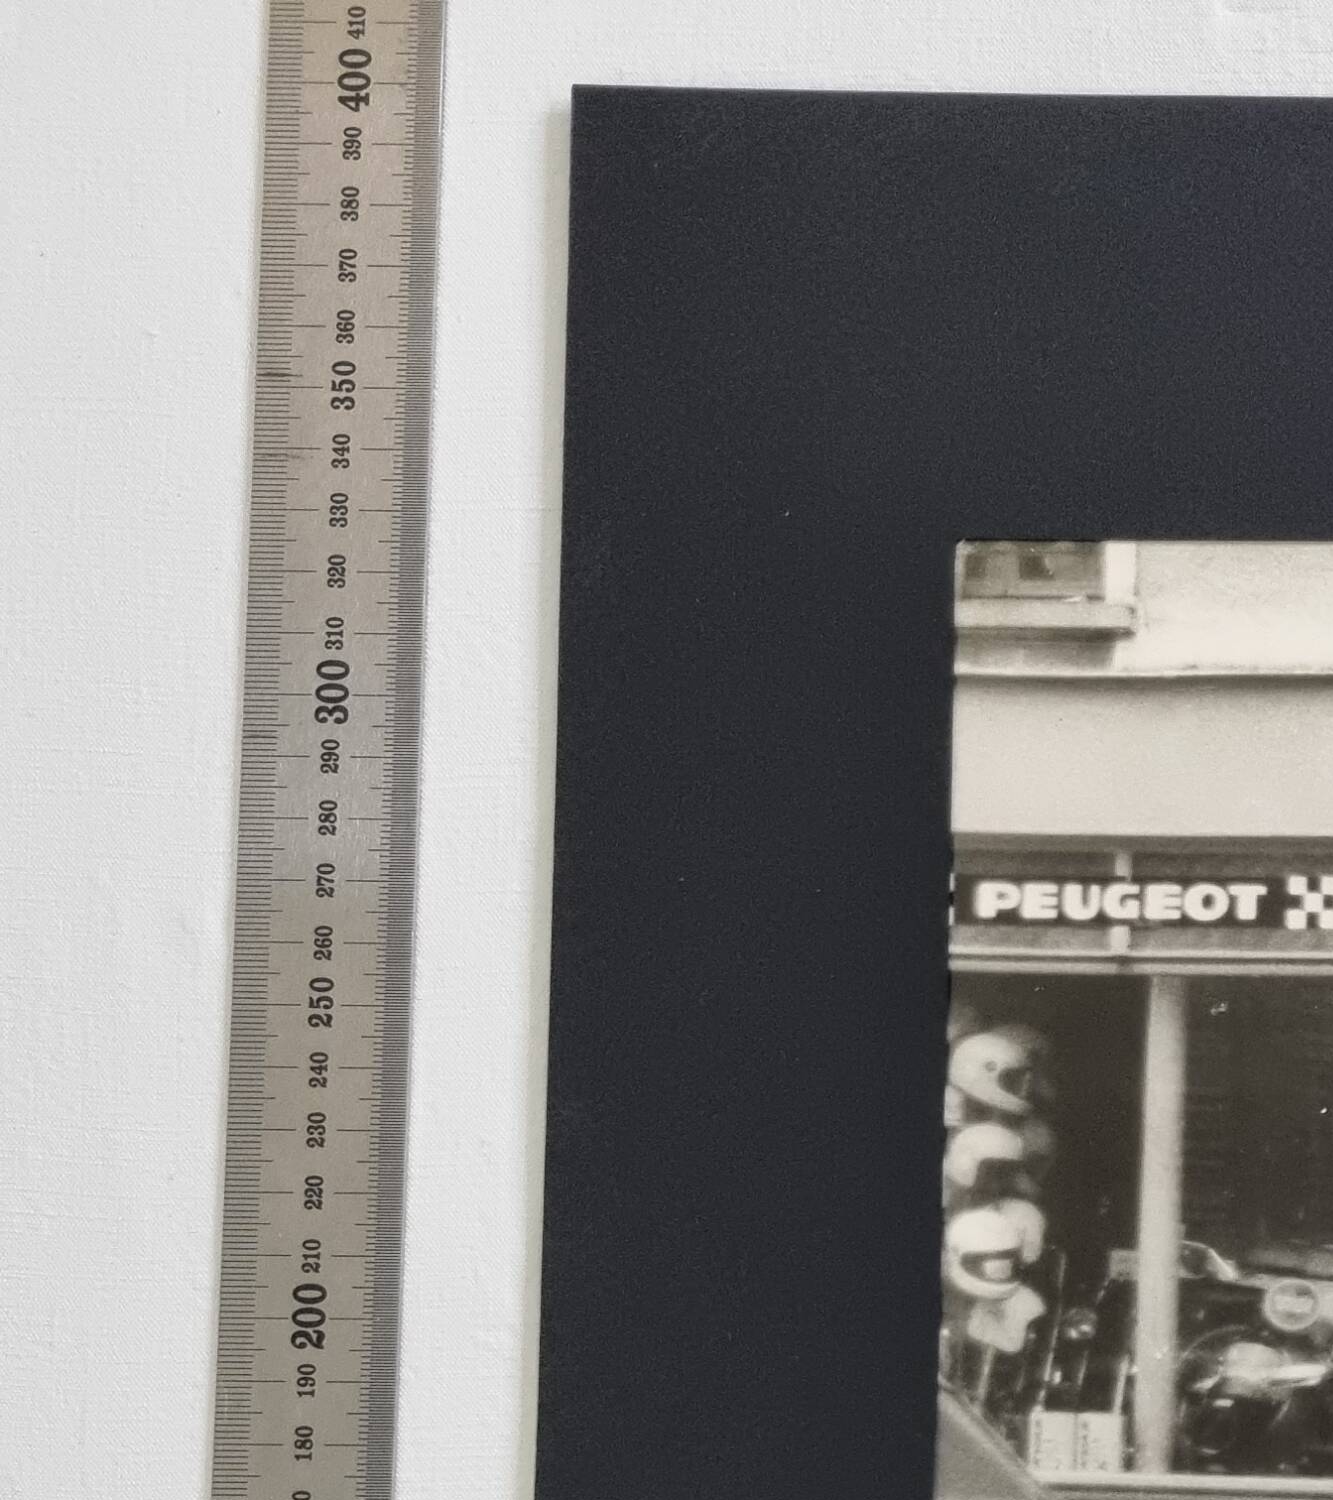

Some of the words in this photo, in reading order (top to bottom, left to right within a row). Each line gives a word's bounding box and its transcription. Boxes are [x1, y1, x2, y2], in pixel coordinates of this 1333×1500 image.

[346, 5, 367, 40] 410
[336, 48, 373, 113] 400
[341, 126, 363, 161] 390
[339, 185, 360, 222] 380
[337, 248, 358, 283] 370
[335, 309, 356, 345] 360
[329, 360, 357, 411] 350
[330, 433, 351, 470] 340
[328, 492, 349, 529] 330
[326, 553, 347, 589] 320
[324, 616, 345, 651] 310
[313, 659, 351, 725] 300
[319, 738, 341, 774] 290
[317, 799, 338, 836] 280
[315, 862, 336, 899] 270
[974, 881, 1268, 921] PEUGEOT
[312, 925, 334, 961] 260
[307, 976, 335, 1029] 250
[307, 1051, 329, 1089] 240
[305, 1111, 327, 1149] 230
[303, 1174, 325, 1211] 220
[300, 1238, 322, 1274] 210
[290, 1283, 328, 1350] 200
[296, 1363, 317, 1398] 190
[293, 1425, 314, 1462] 180
